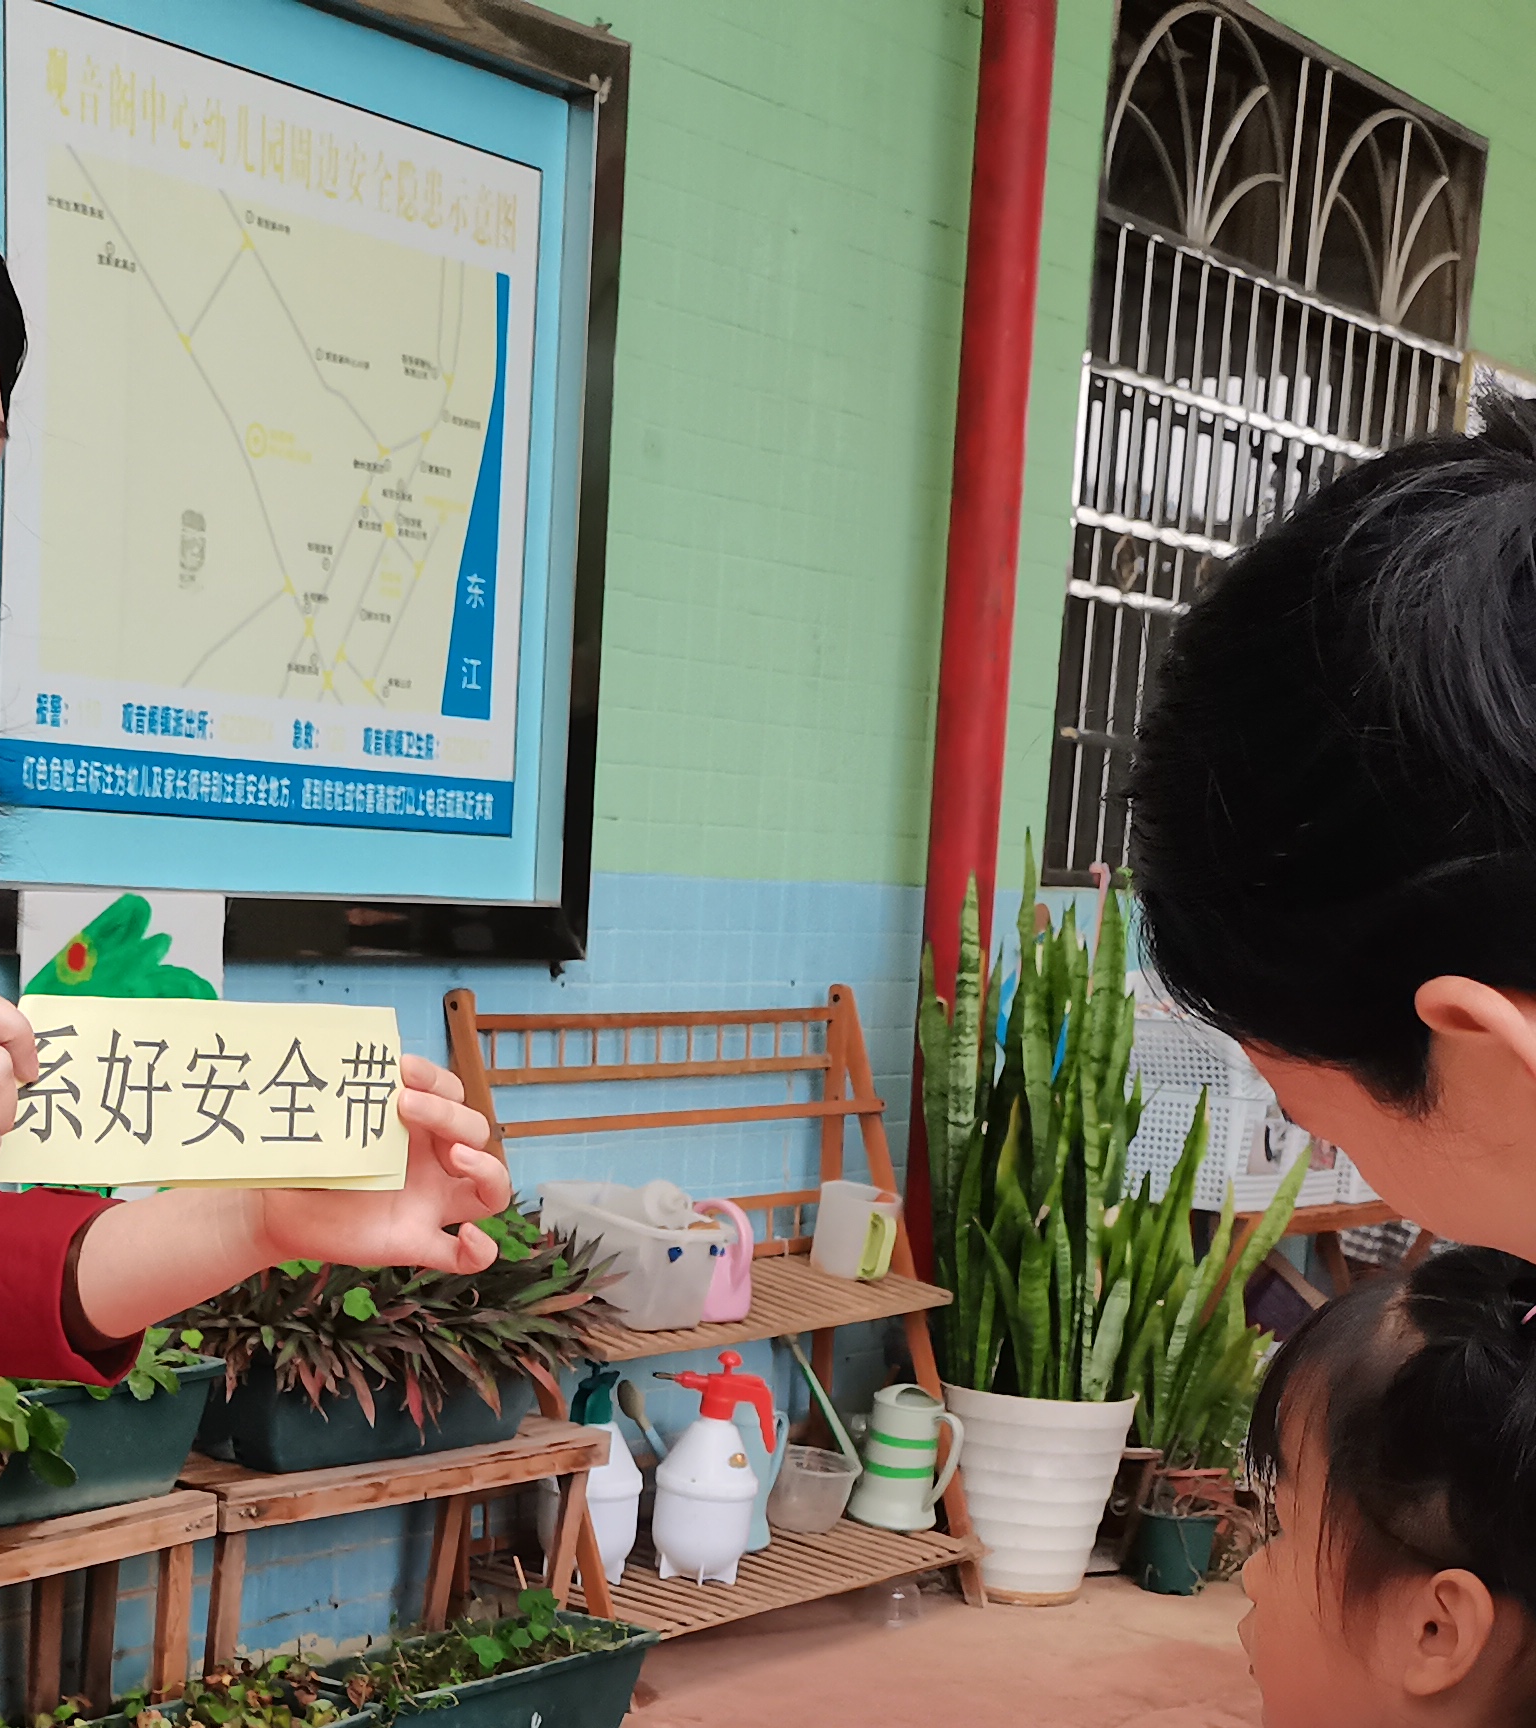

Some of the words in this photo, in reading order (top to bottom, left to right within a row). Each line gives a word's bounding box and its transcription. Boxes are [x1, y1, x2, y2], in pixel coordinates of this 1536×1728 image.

[461, 572, 488, 692] 东江
[12, 1024, 397, 1149] 系好安全带
